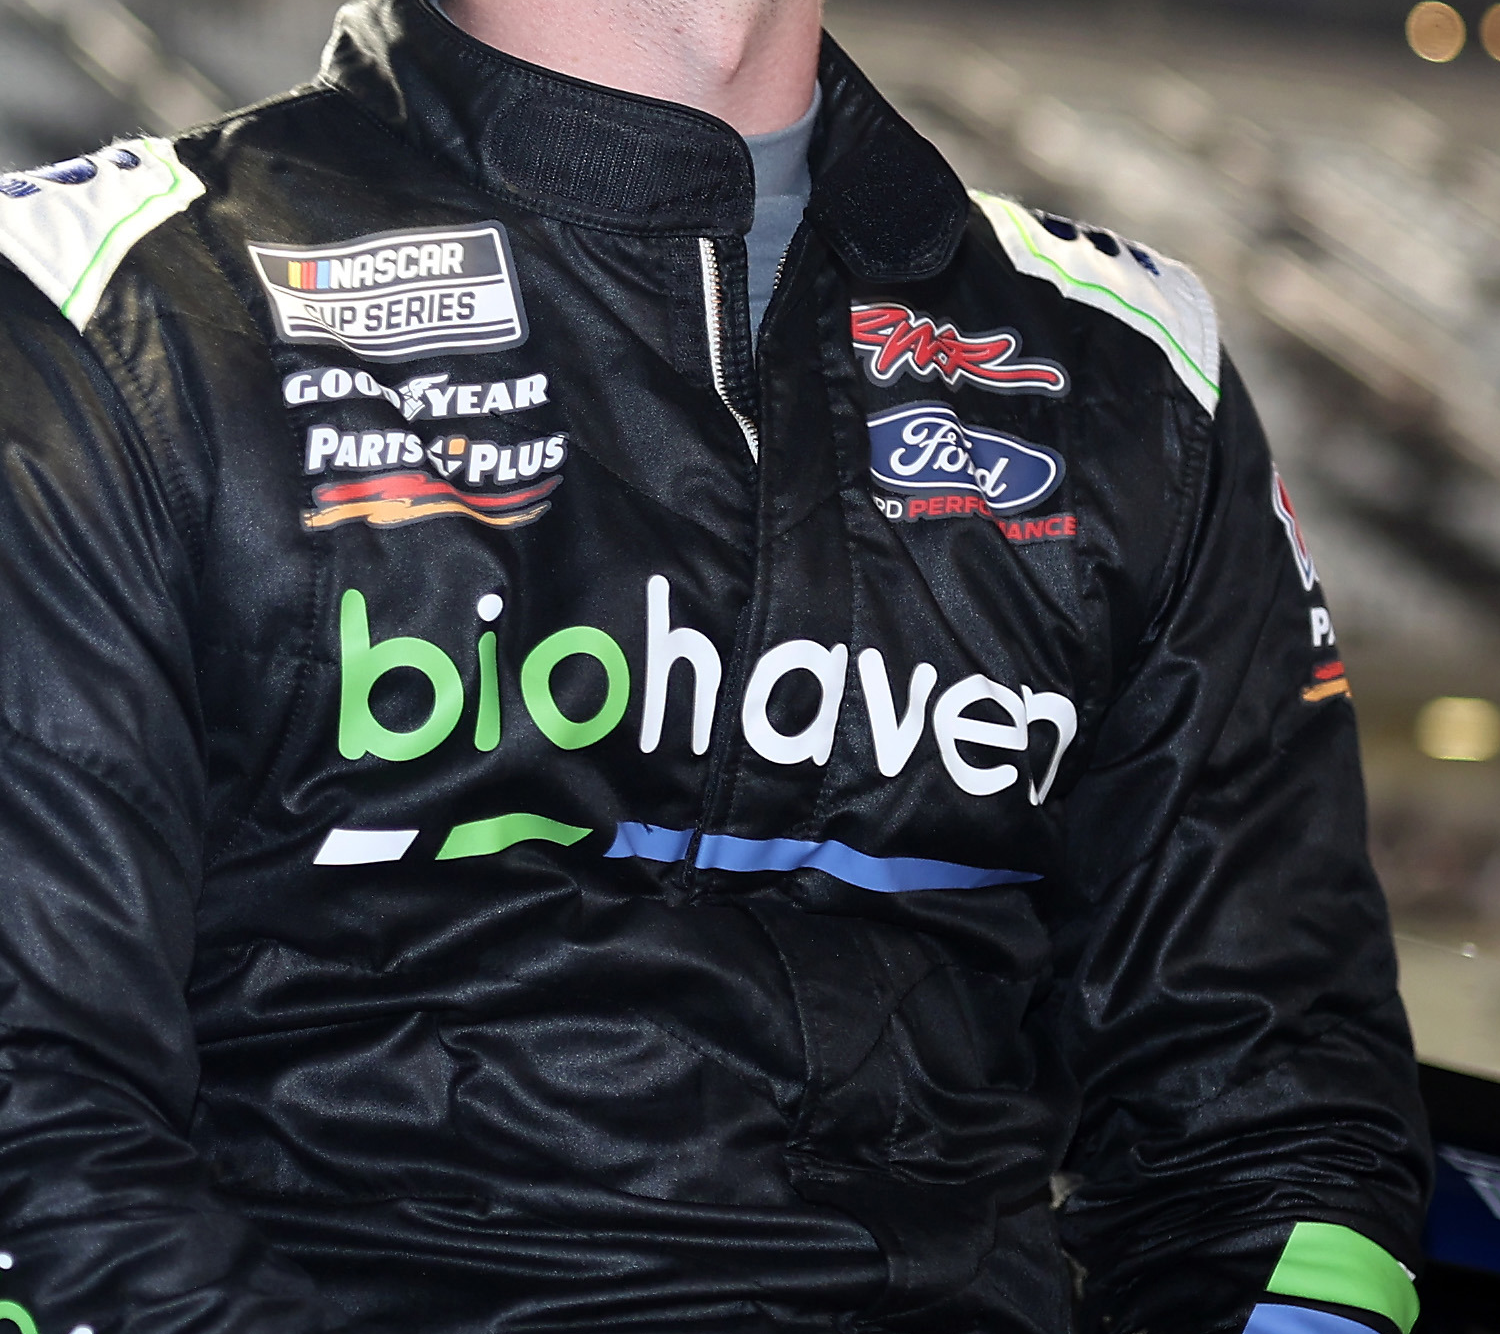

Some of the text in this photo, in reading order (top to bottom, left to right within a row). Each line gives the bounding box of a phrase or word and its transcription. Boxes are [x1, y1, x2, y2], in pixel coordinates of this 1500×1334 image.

[330, 242, 464, 289] NASCAR
[364, 292, 476, 331] SERIES
[308, 427, 566, 482] PARTS PLUS
[873, 497, 903, 518] RD
[338, 574, 1078, 805] biohaven
